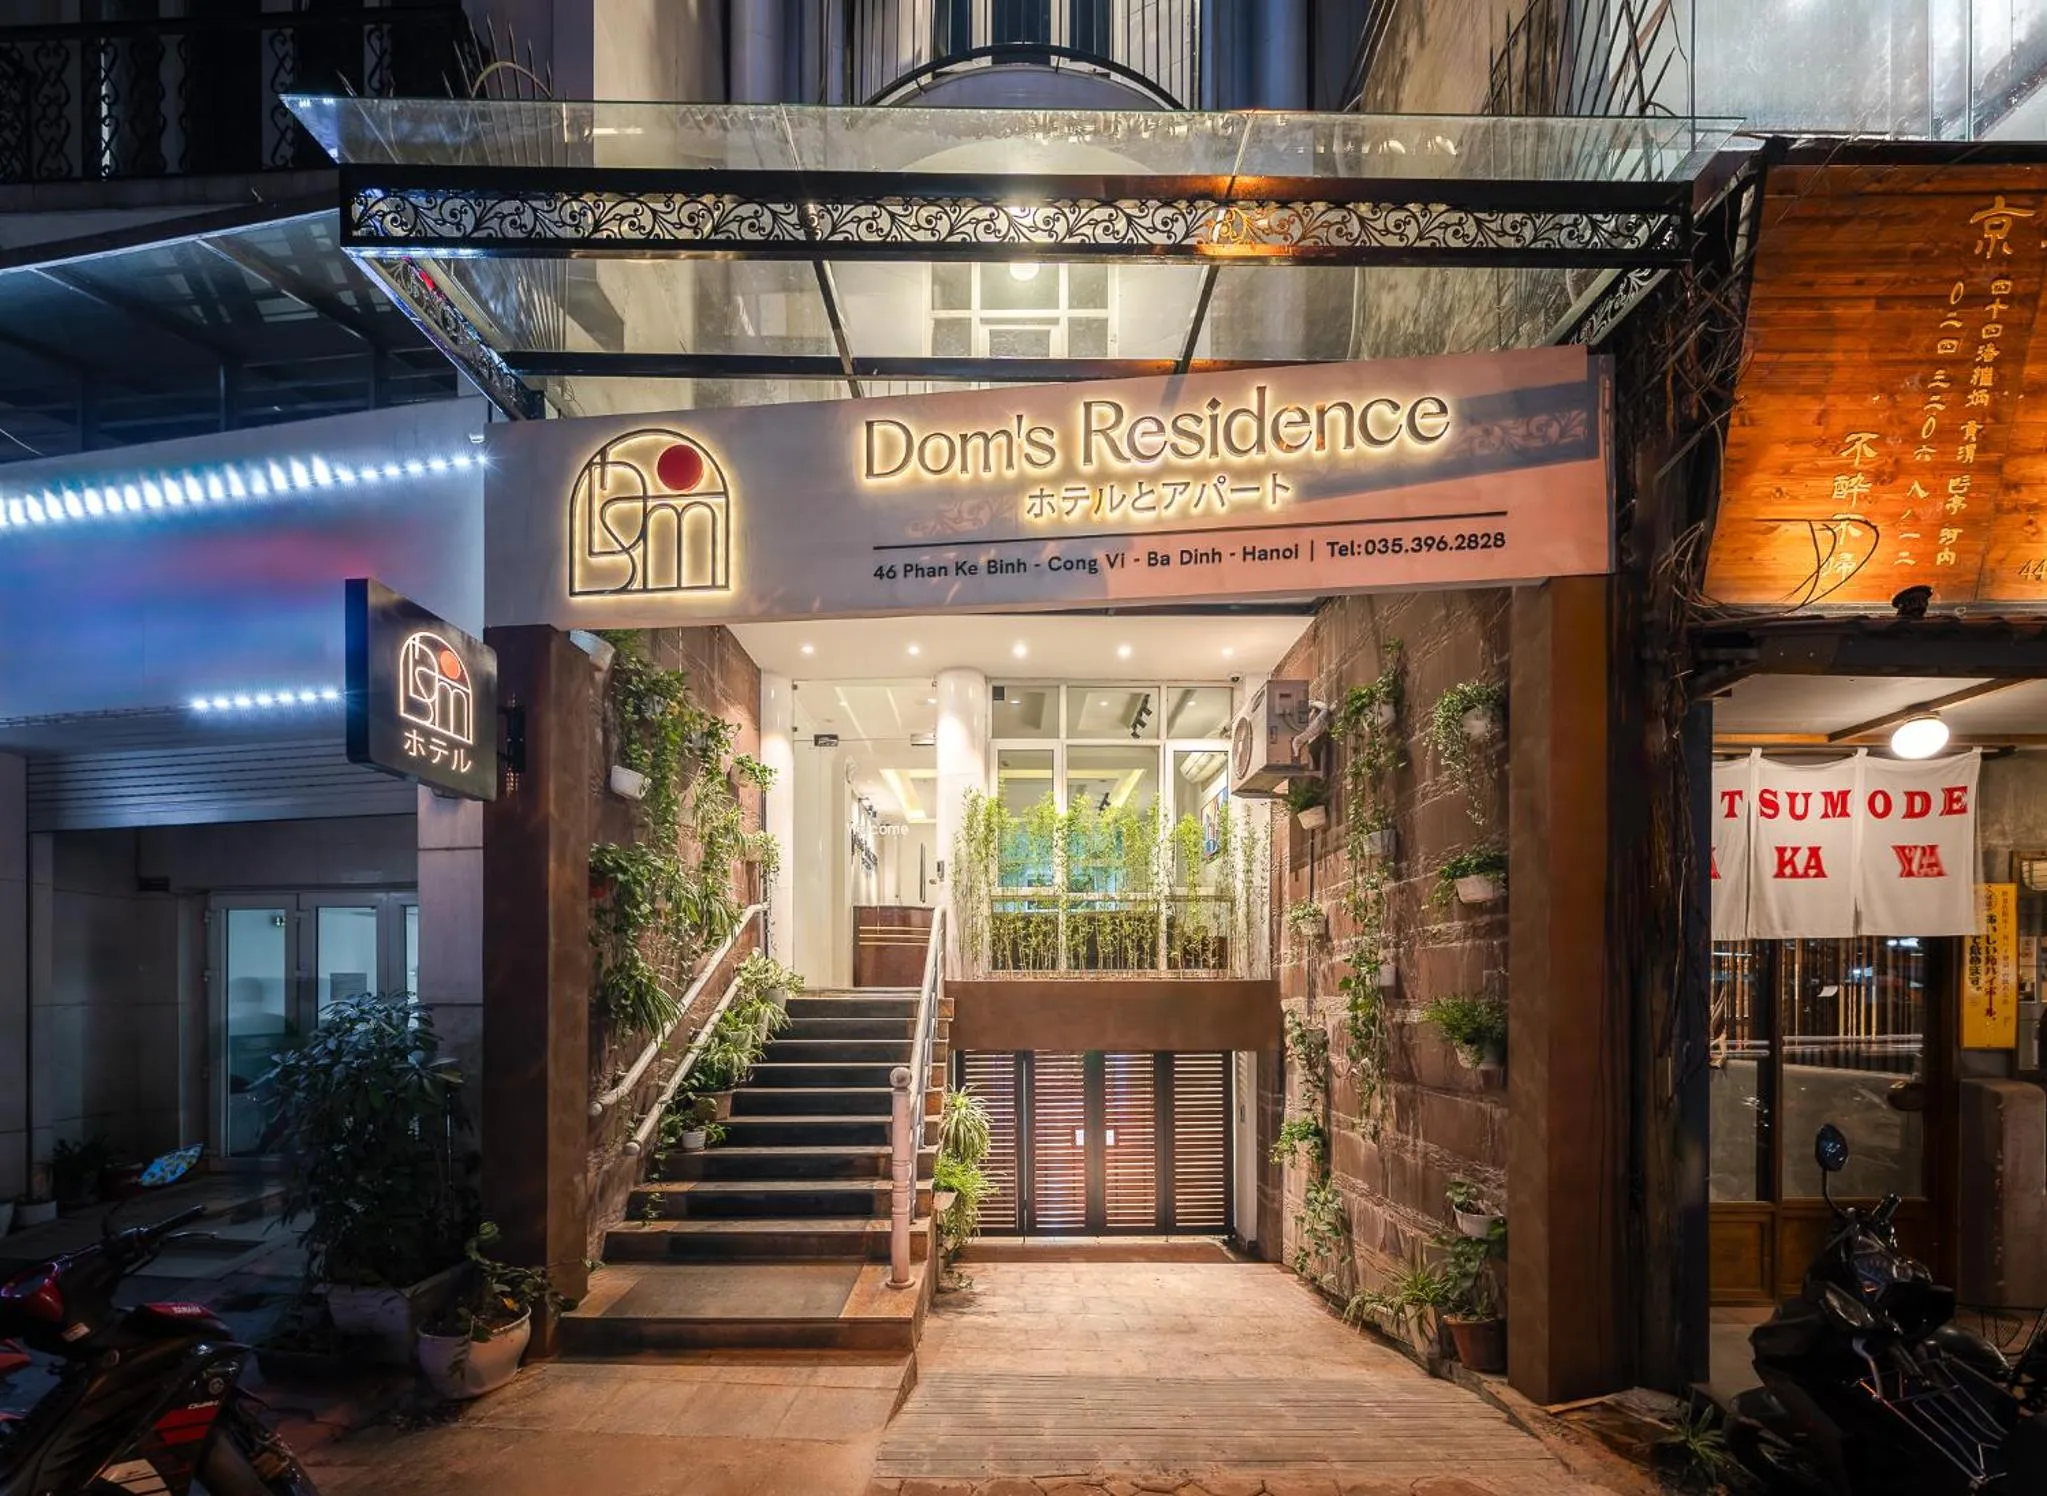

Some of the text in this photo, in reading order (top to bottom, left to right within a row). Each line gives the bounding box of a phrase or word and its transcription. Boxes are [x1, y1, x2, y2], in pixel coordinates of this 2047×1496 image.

[1969, 195, 2035, 259] 京
[864, 385, 1450, 480] Dom's Residence
[1026, 472, 1293, 520] ホテルとアパート
[873, 564, 898, 581] 46
[903, 562, 949, 579] Phan
[954, 560, 979, 577] Ke
[986, 557, 1028, 576] Binh
[1047, 555, 1100, 575] Cong
[1104, 552, 1126, 570] Vi
[1147, 550, 1171, 568] Ba
[1179, 547, 1223, 567] Dinh
[1241, 543, 1300, 564] Hanoi
[1326, 531, 1507, 559] Tel:035.396.2828
[403, 728, 473, 774] ホテル
